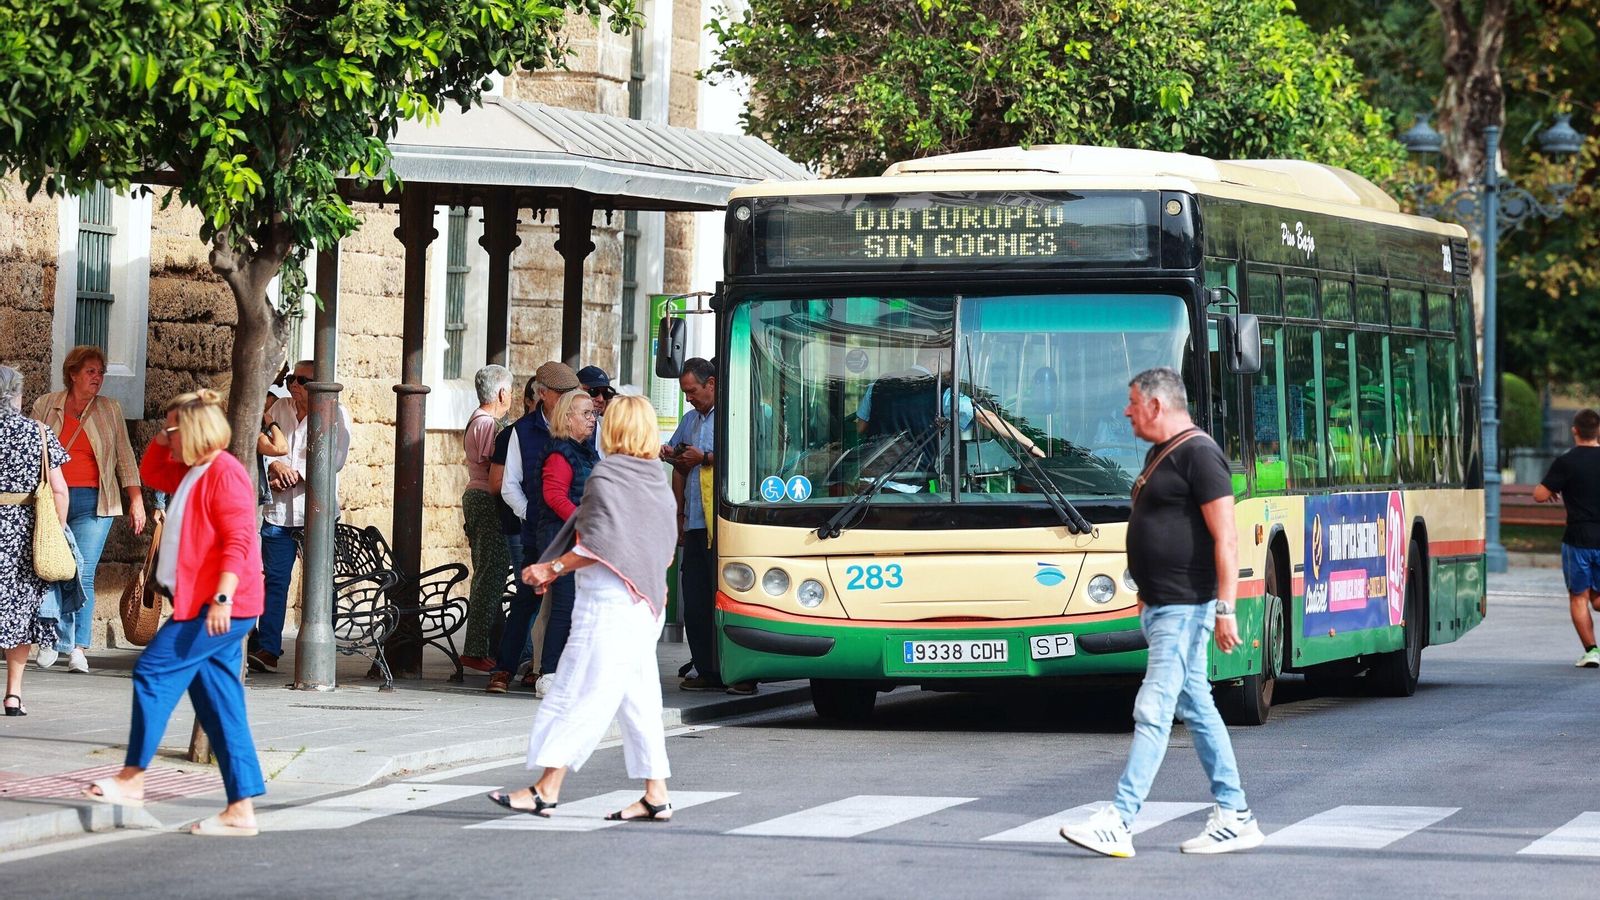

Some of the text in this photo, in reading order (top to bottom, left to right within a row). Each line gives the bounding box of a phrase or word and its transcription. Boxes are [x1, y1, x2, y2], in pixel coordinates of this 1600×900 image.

[922, 205, 1064, 230] EUROPEO
[864, 232, 1058, 258] SIN COCHES
[1296, 221, 1316, 260] Bajo
[845, 563, 904, 591] 283
[914, 642, 1005, 661] 9338 CDH
